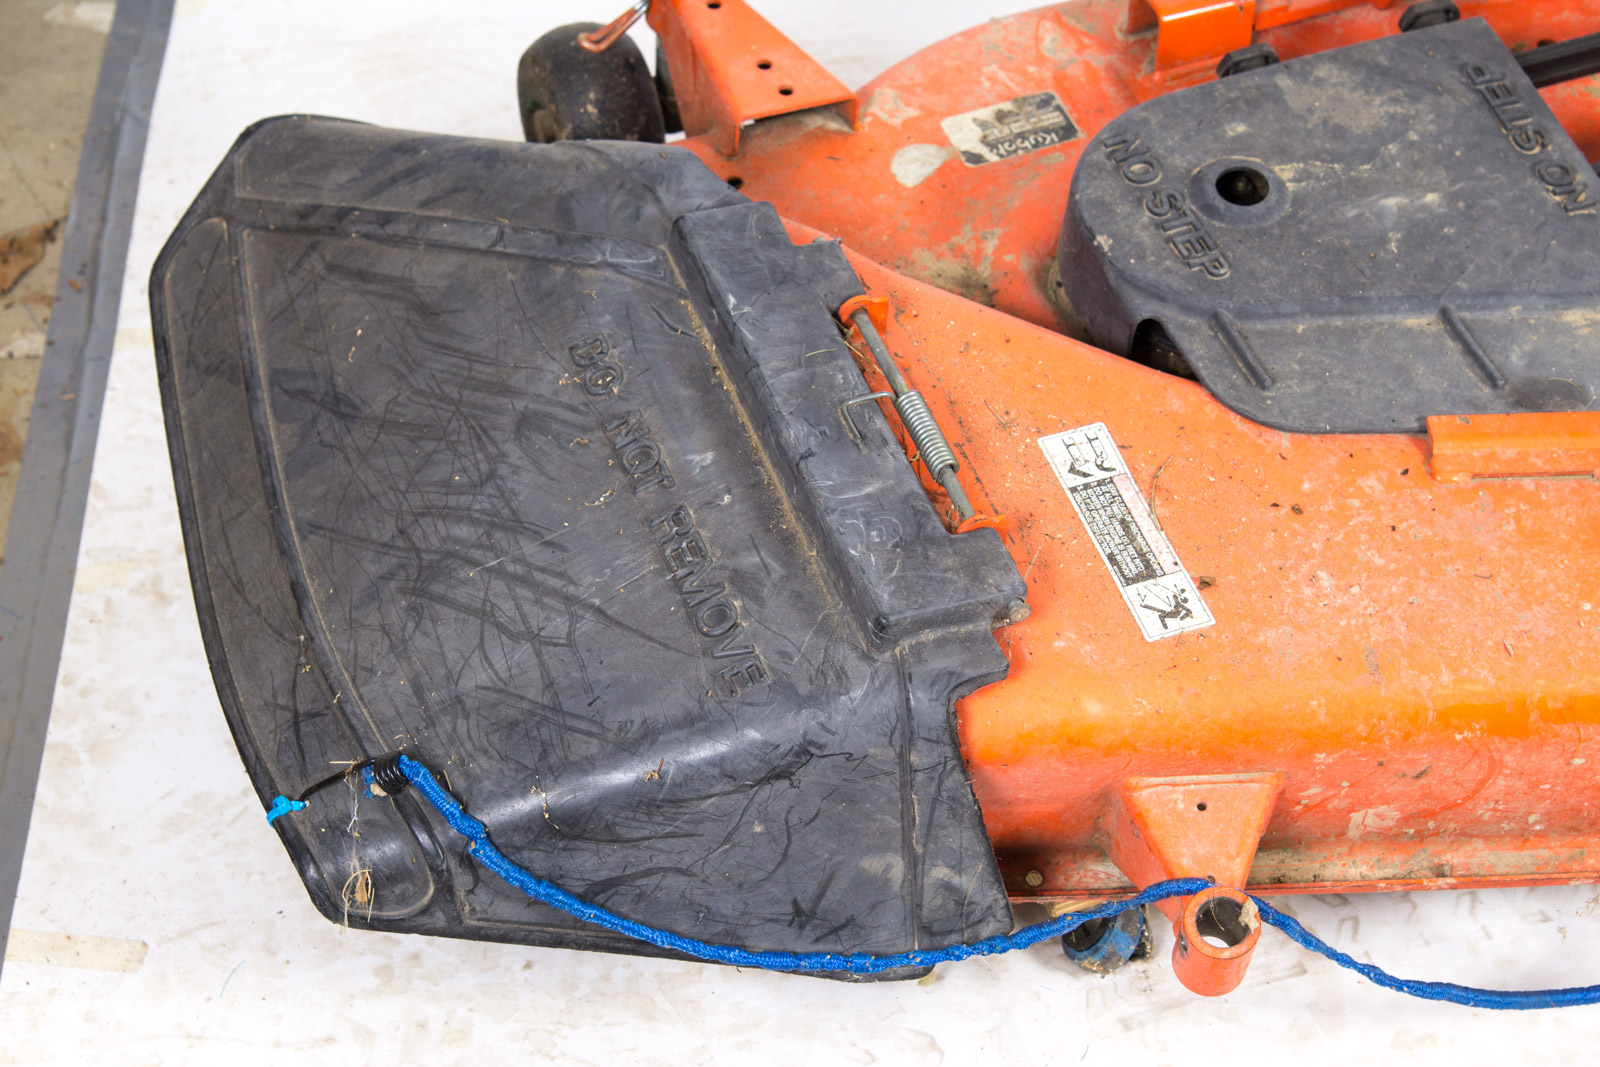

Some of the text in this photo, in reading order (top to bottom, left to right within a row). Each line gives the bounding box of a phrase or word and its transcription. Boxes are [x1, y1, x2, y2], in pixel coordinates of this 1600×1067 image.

[1461, 63, 1598, 215] NO STEP
[1103, 134, 1230, 280] NO STEP
[1092, 486, 1103, 496] DO
[1106, 482, 1119, 496] STAY
[1085, 488, 1102, 509] MOWER
[1097, 494, 1109, 507] NOT
[1103, 492, 1115, 504] ALL
[569, 332, 771, 698] DO NOT REMOVE
[1078, 490, 1089, 499] DO
[1089, 509, 1109, 534] OPERATE
[1103, 533, 1120, 555] MOWER
[1123, 513, 1134, 522] OF
[1127, 521, 1151, 553] DISCHARGE
[1124, 544, 1138, 559] FEET
[1132, 557, 1145, 571] INTO
